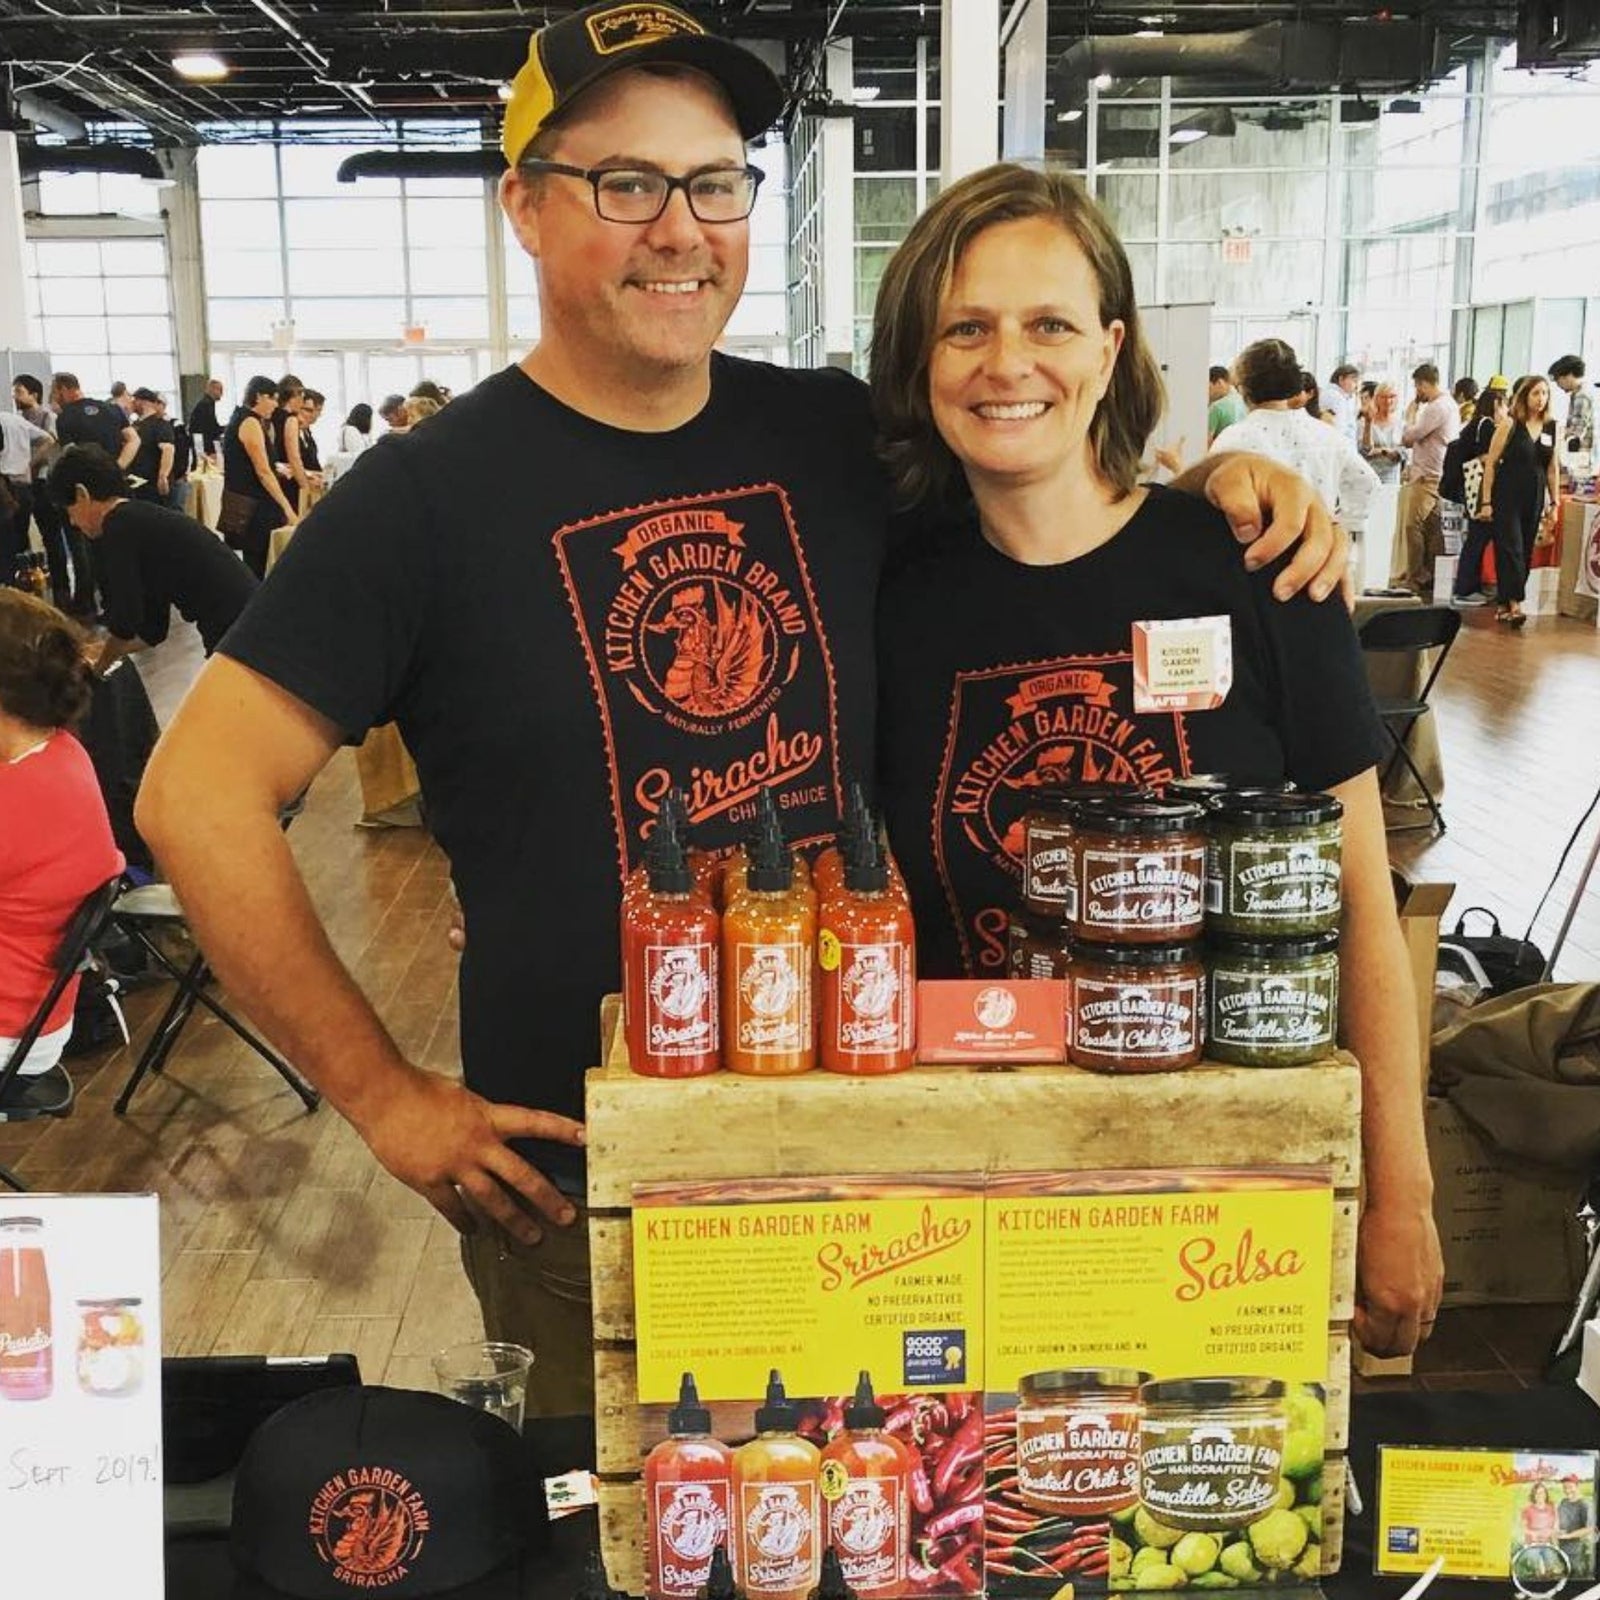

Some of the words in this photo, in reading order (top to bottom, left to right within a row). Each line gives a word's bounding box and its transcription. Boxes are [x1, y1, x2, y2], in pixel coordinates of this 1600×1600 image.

[638, 513, 715, 544] ORGANIC
[605, 569, 654, 673] KITCHEN
[648, 543, 742, 580] GARDEN
[746, 560, 807, 635] BRAND
[1029, 673, 1090, 697] ORGANIC
[951, 722, 1029, 814] KITCHEN
[1034, 705, 1136, 747] GARDEN
[636, 712, 823, 841] Siracha
[779, 785, 828, 810] SAUCE
[1032, 848, 1068, 871] KITCHEN
[1031, 875, 1068, 896] Roaste
[1089, 870, 1136, 896] KITCHEN
[1237, 860, 1288, 887] KITCHEN
[1088, 899, 1141, 921] Roasted
[1080, 1000, 1121, 1022] KITCHEN
[1121, 999, 1166, 1017] GARDEN
[1218, 991, 1262, 1014] KITCHEN
[1263, 989, 1307, 1005] GARDEN
[1221, 1017, 1285, 1039] Tomatillo
[647, 1216, 731, 1242] KITCHEN
[738, 1213, 815, 1238] GARDEN
[821, 1211, 872, 1235] FARM
[998, 1207, 1081, 1231] KITCHEN
[1088, 1205, 1163, 1229] GARDEN
[1171, 1203, 1220, 1226] FARM
[817, 1202, 971, 1292] Sriracha
[1174, 1228, 1306, 1303] Salsa
[894, 1275, 933, 1287] FARMER
[936, 1273, 963, 1286] MADE
[868, 1295, 881, 1307] NO
[883, 1292, 964, 1306] PRESERVATIVES
[1236, 1304, 1276, 1317] FARMER
[1278, 1303, 1305, 1316] MADE
[864, 1313, 916, 1326] CERTIFIED
[918, 1310, 964, 1323] ORGANIC
[1210, 1325, 1223, 1336] NO
[1225, 1323, 1305, 1336] PRESERVATIVES
[906, 1336, 943, 1346] GOOD
[906, 1347, 943, 1357] FOOD
[1205, 1342, 1257, 1356] CERTIFIED
[1259, 1341, 1304, 1354] ORGANIC
[1069, 1427, 1128, 1449] GARDEN
[1047, 1450, 1127, 1461] HANDCRAFTED
[1143, 1446, 1188, 1469] KITCHEN
[1192, 1442, 1252, 1463] GARDEN
[1073, 1467, 1121, 1493] Chili
[1167, 1464, 1251, 1475] HANDCRAFTED
[309, 1475, 346, 1535] KITCHEN
[348, 1466, 411, 1494] GARDEN
[405, 1490, 431, 1533] FARM
[1143, 1477, 1220, 1506] Tomatillo
[1223, 1476, 1274, 1509] Salsa
[332, 1564, 409, 1590] SRIRACHA
